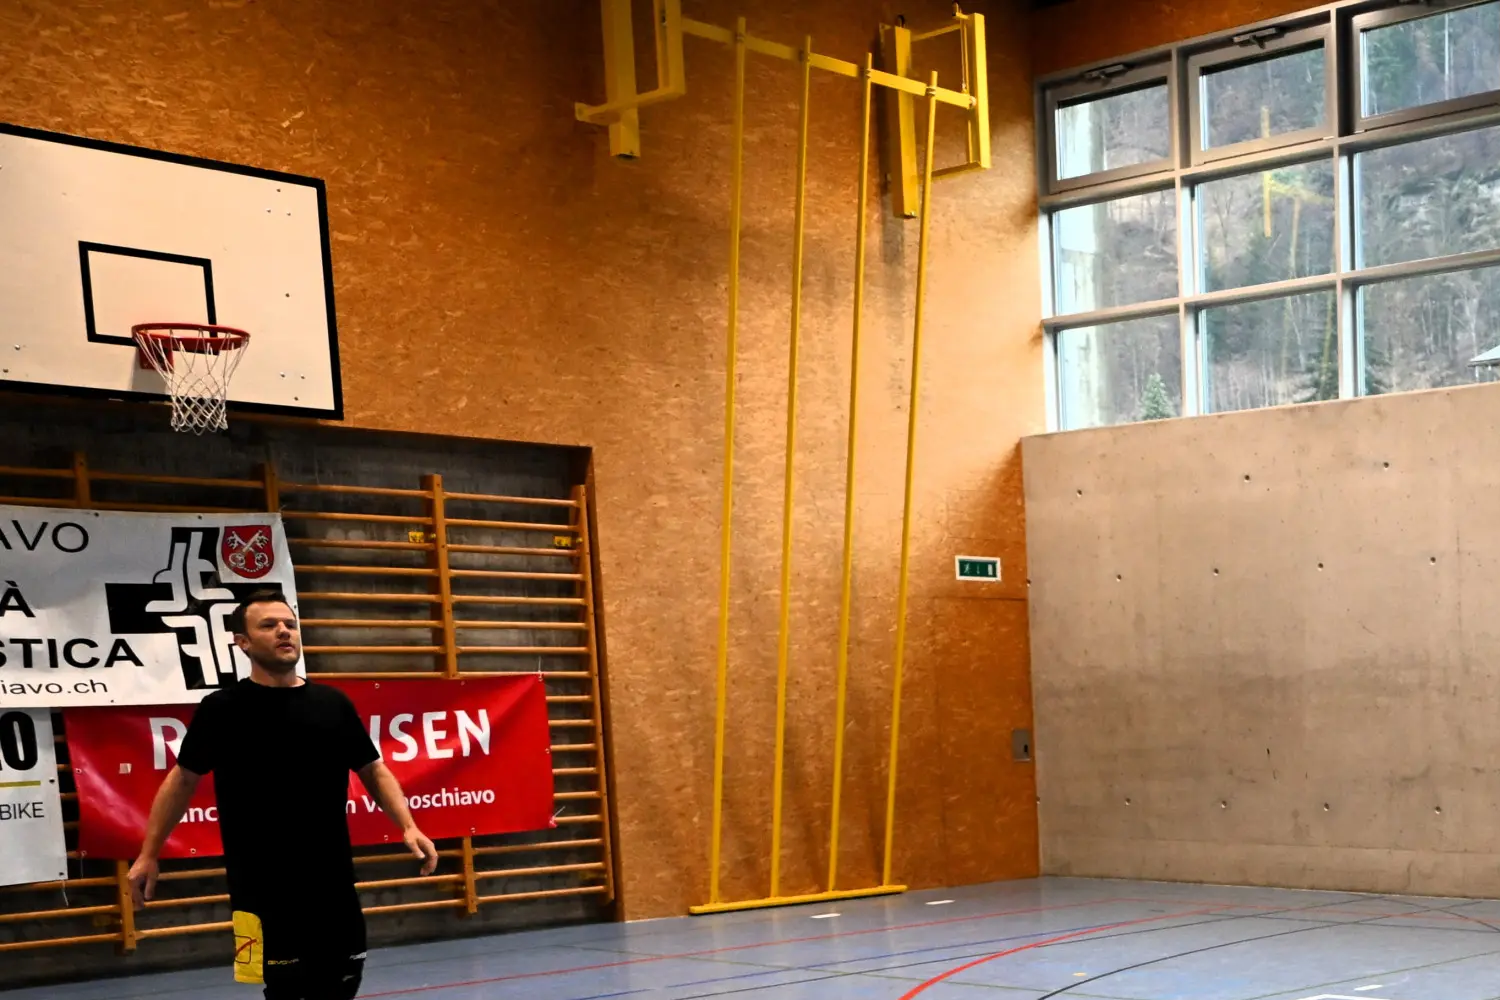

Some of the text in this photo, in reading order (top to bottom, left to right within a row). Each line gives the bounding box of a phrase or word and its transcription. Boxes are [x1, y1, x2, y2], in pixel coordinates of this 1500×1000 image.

[0, 637, 145, 669] TICA
[0, 710, 38, 771] O
[0, 802, 45, 821] BIKE
